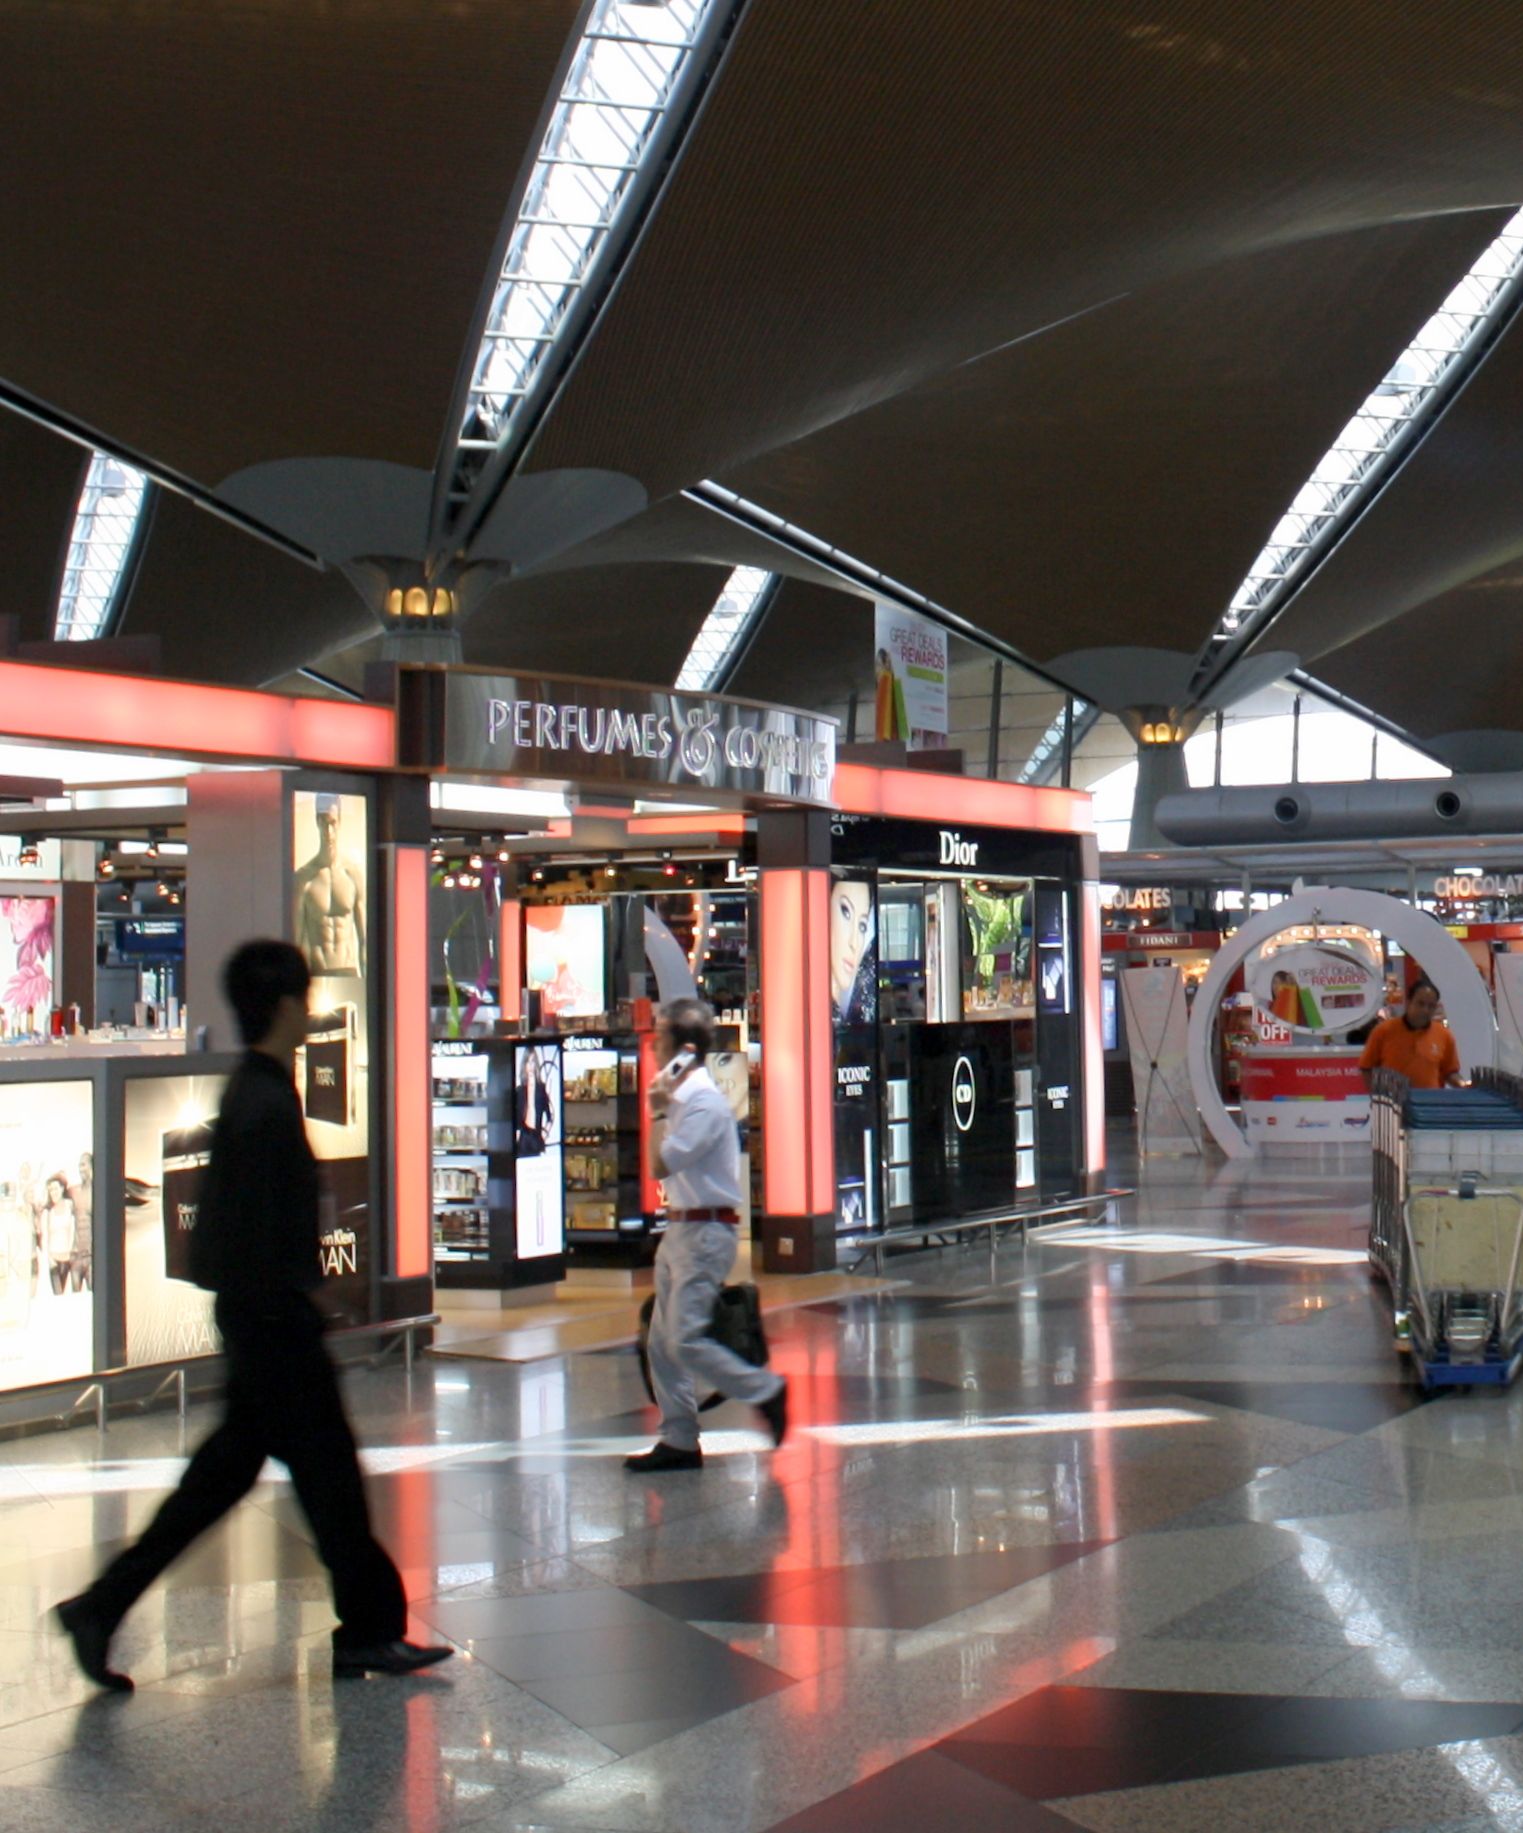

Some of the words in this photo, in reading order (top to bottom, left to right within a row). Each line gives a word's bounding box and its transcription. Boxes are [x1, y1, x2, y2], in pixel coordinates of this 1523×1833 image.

[890, 627, 916, 648] GREAT
[901, 645, 945, 671] REWARDS
[488, 699, 672, 759] PERFUMES
[681, 708, 720, 777] &
[939, 830, 979, 866] Dior
[1311, 975, 1367, 986] REWARDS
[1261, 1024, 1290, 1040] OFF
[838, 1066, 871, 1084] ICONIC
[1296, 1067, 1342, 1077] MALAYSIA
[178, 1213, 198, 1230] MA
